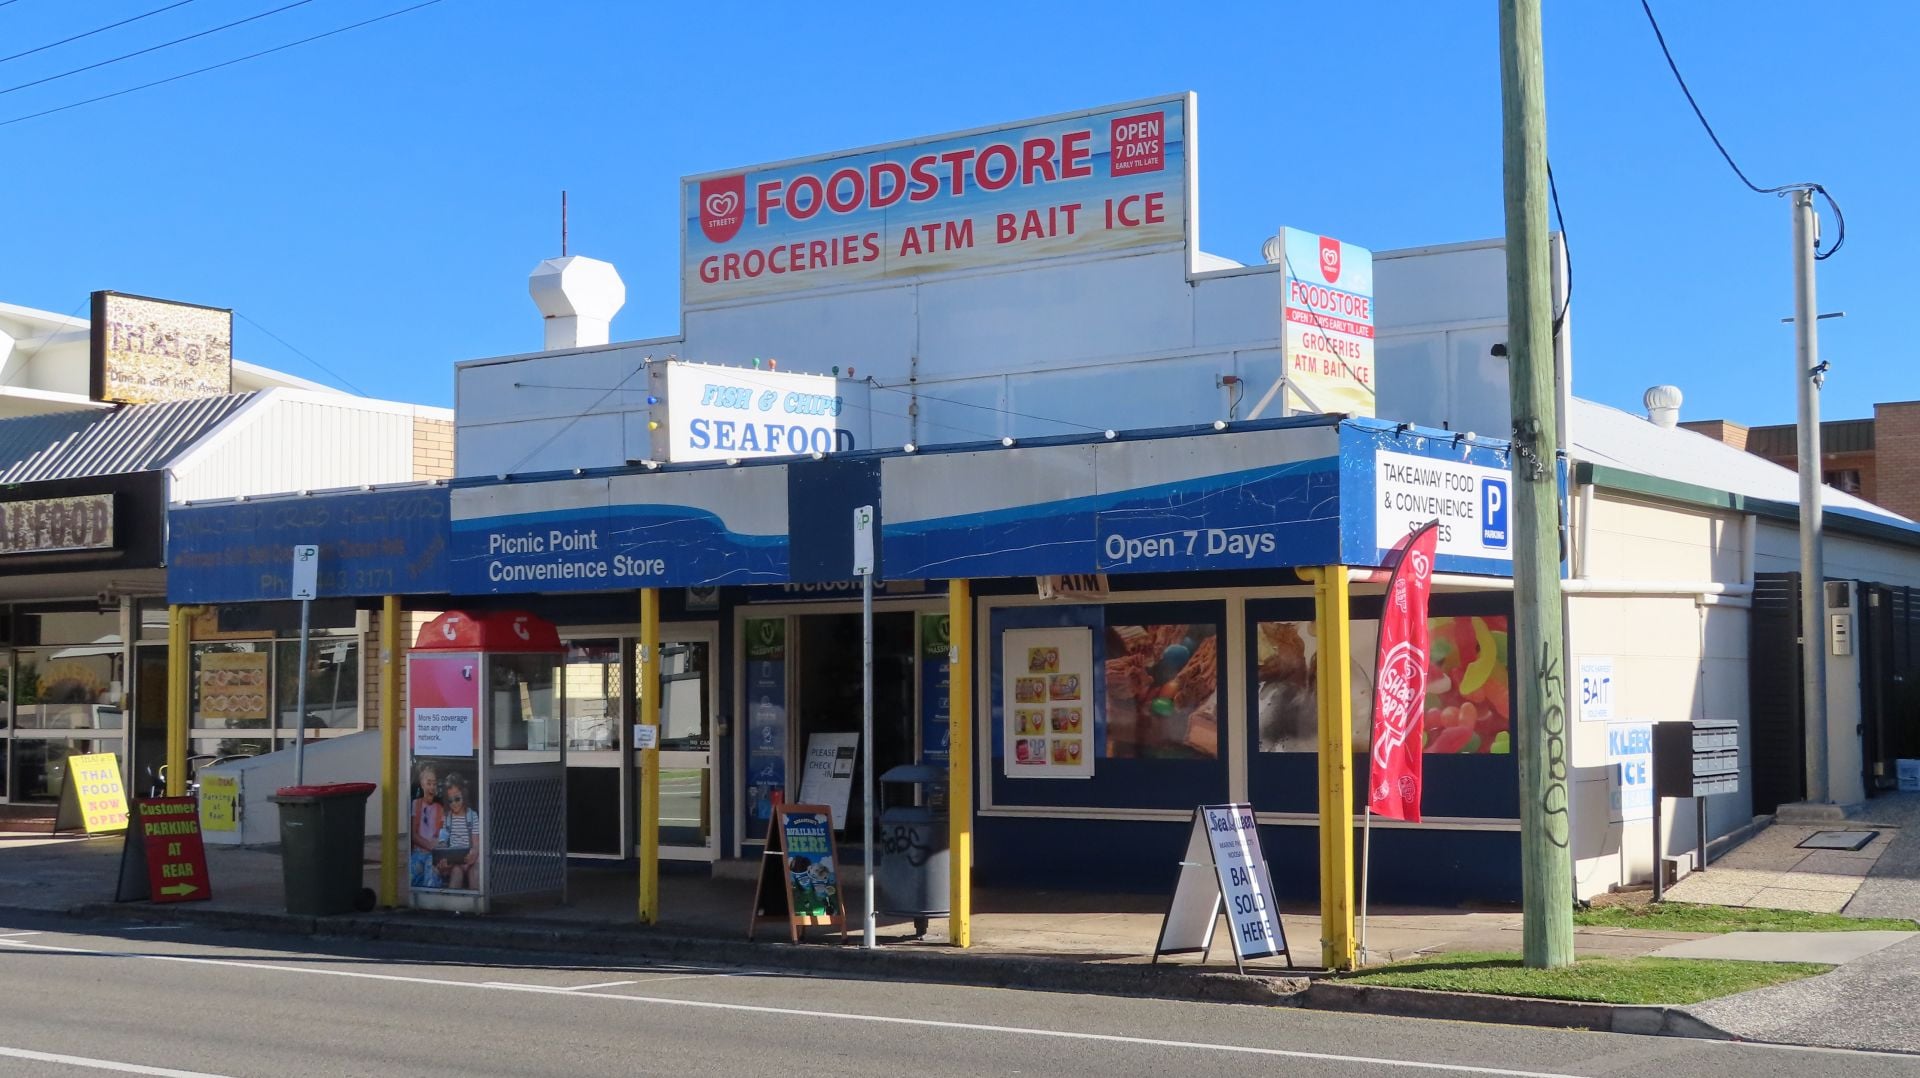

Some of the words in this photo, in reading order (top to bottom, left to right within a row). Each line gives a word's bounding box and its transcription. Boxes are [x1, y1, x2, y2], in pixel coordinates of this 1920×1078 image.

[1116, 120, 1158, 141] OPEN
[1116, 146, 1123, 159] 7
[1127, 140, 1158, 157] DAYS
[1116, 161, 1133, 169] EARLY
[1145, 157, 1158, 165] LATE
[758, 131, 1092, 225] FOODSTORE
[709, 218, 735, 227] STREETS
[700, 232, 880, 284] GROCERIES
[900, 219, 974, 256] ATM
[997, 203, 1081, 244] BAIT
[1105, 192, 1165, 229] ICE
[1291, 282, 1369, 319] FOODSTORE
[1292, 311, 1309, 323] OPEN
[1314, 315, 1329, 328] DAYS
[1330, 319, 1346, 332] EARLY
[1355, 325, 1369, 336] LATE
[1302, 333, 1360, 358] GROCERIES
[1295, 354, 1317, 373] ATM
[1323, 360, 1346, 379] BAIT
[1353, 366, 1369, 383] ICE
[701, 384, 753, 410] FISH
[758, 390, 778, 411] &
[784, 392, 843, 416] CHIPS
[690, 418, 855, 454] SEAFOOD
[1384, 463, 1443, 488] TAKEAWAY
[1445, 472, 1474, 493] FOOD
[1384, 491, 1392, 509] &
[1396, 493, 1474, 519] CONVENIENCE
[1488, 485, 1501, 525] P
[489, 533, 544, 555] Picnic
[550, 529, 598, 551] Point
[1408, 521, 1452, 542] STES
[1484, 529, 1504, 540] PARKING
[1105, 533, 1175, 564] Open
[1183, 531, 1196, 555] 7
[1207, 528, 1276, 559] Days
[489, 558, 607, 582] Convenience
[613, 554, 665, 577] Store
[1583, 677, 1610, 705] BAIT
[431, 725, 440, 733] any
[441, 714, 468, 723] coverage
[812, 748, 836, 757] PLEASE
[81, 769, 113, 780] THAI
[809, 761, 831, 769] CHECK
[1617, 761, 1647, 787] ICE
[82, 783, 119, 795] FOOD
[89, 800, 119, 811] NOW
[140, 803, 196, 815] Customer
[89, 813, 126, 825] OPEN
[145, 821, 198, 836] PARKING
[1210, 811, 1229, 833] Sea
[1227, 810, 1254, 833] Queen
[786, 828, 826, 836] AVAILABLE
[168, 842, 181, 856] AT
[788, 836, 828, 853] HERE
[162, 863, 193, 877] REAR
[1235, 893, 1265, 914] SOLD
[1242, 920, 1273, 943] HERE
